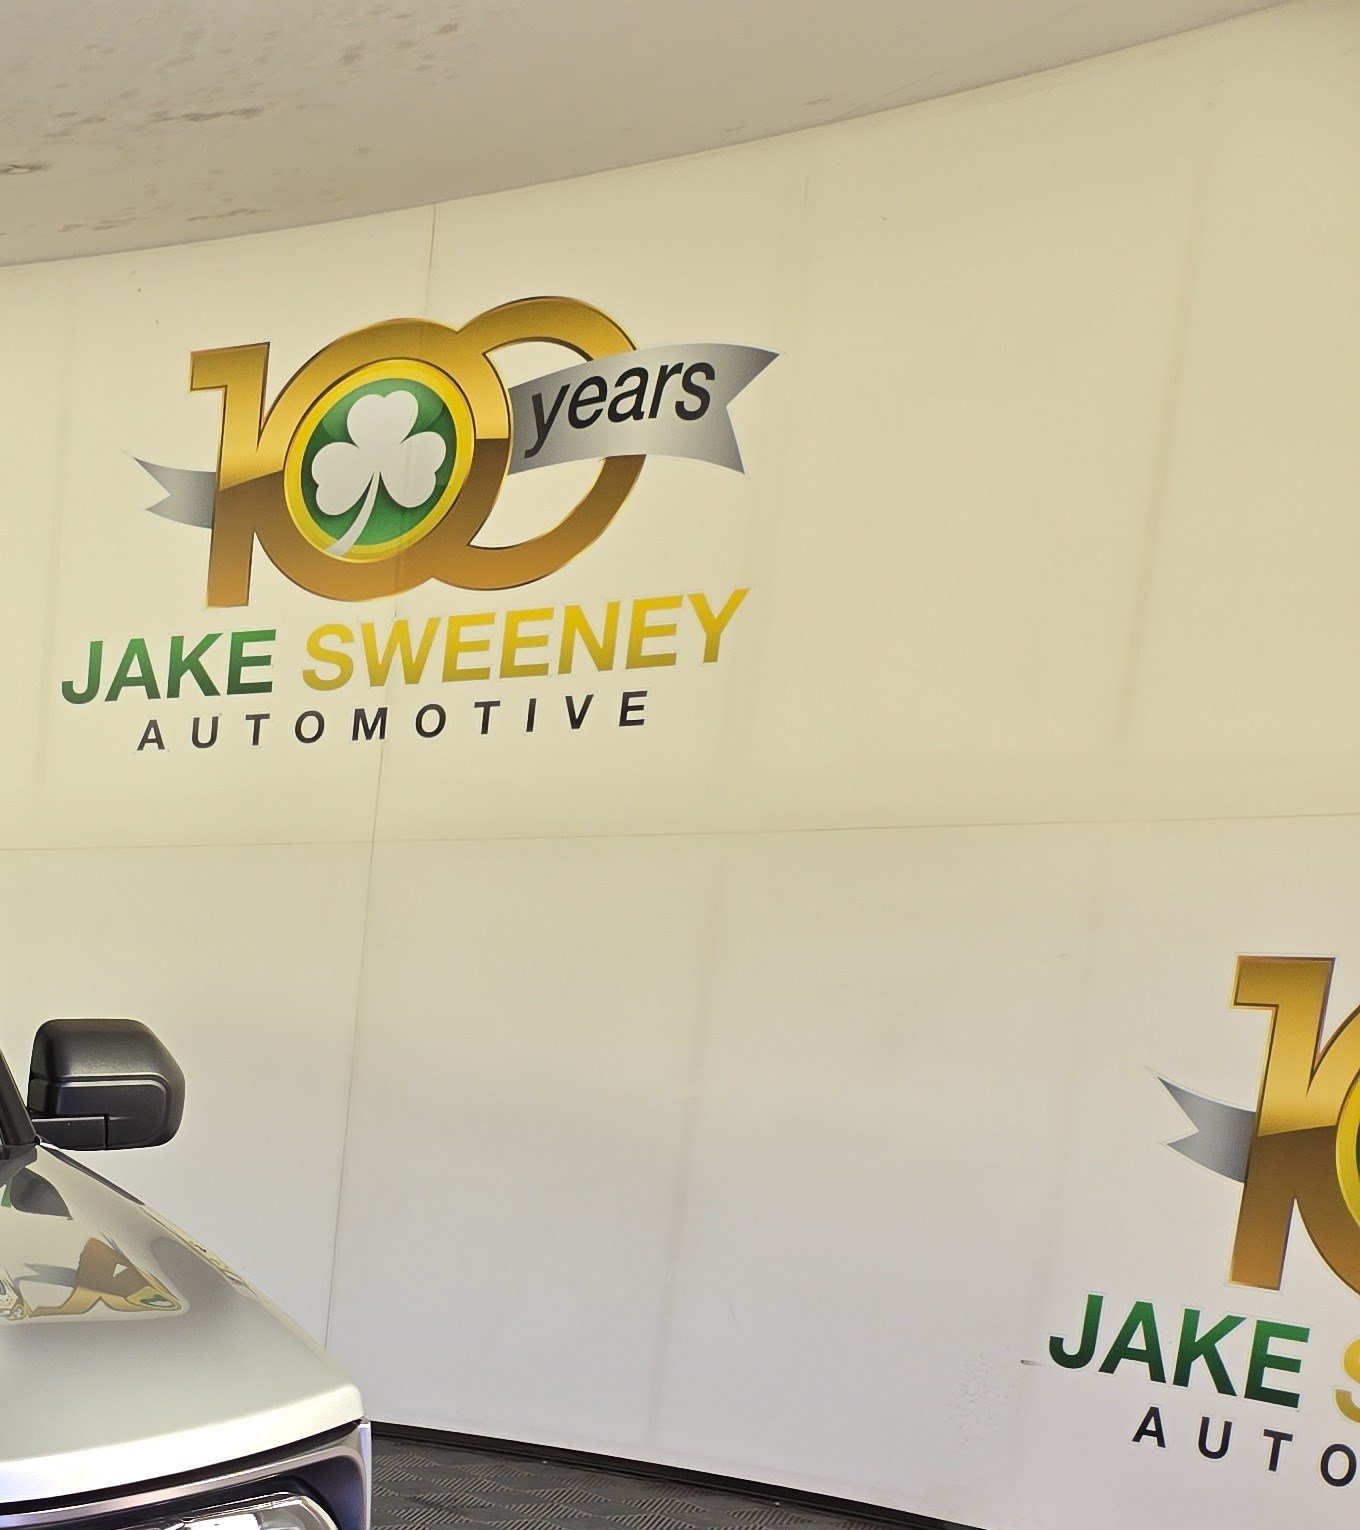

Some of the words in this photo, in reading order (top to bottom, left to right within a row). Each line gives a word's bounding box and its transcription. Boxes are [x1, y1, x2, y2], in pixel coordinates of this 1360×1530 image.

[524, 358, 716, 459] years
[62, 628, 277, 706] JAKE
[302, 587, 750, 693] SWEENEY
[136, 690, 648, 754] AUTOMOTIVE
[1048, 1294, 1310, 1410] JAKE
